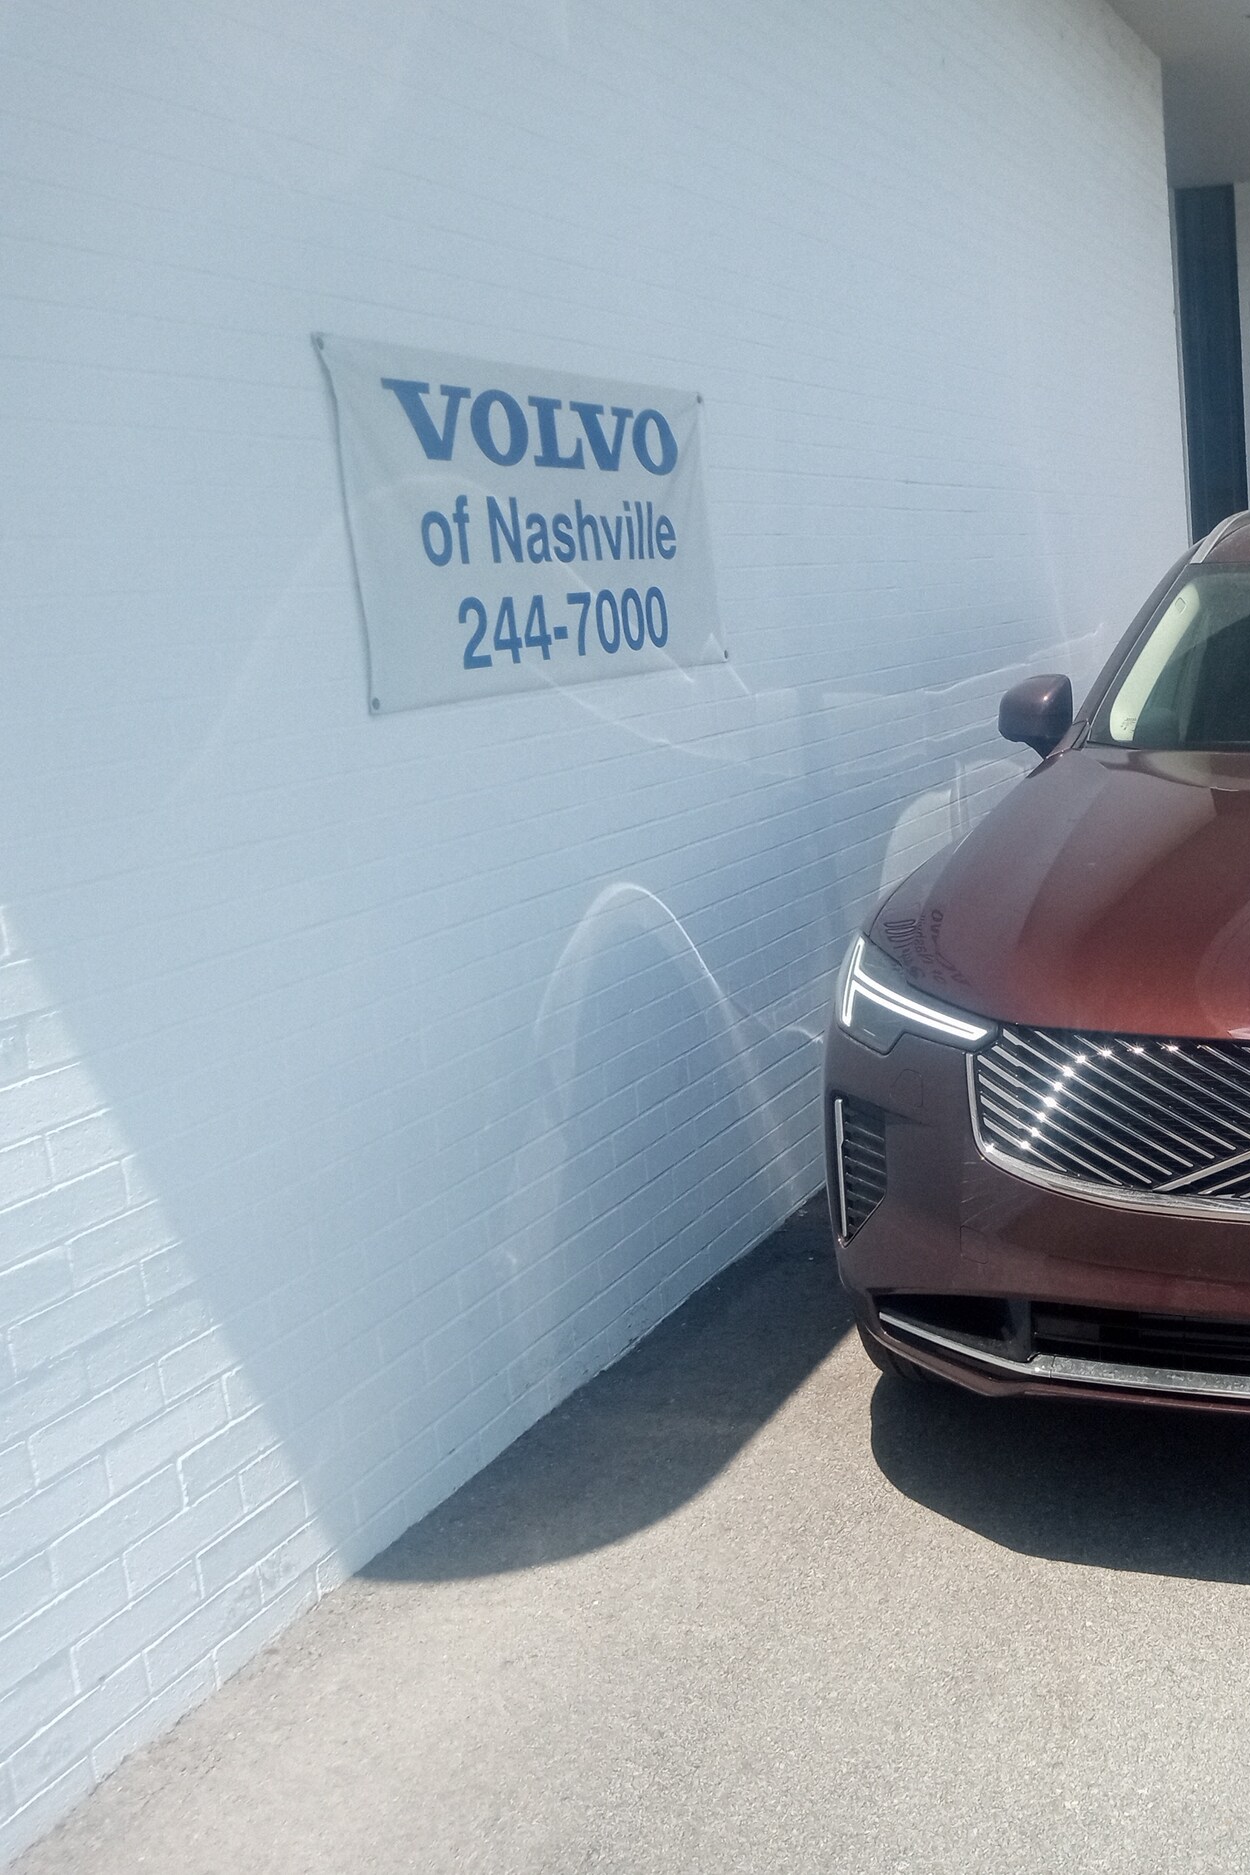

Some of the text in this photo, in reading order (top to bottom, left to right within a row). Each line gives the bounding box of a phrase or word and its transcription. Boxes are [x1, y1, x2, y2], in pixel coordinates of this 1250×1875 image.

[381, 377, 679, 476] VOLVO
[421, 494, 678, 567] of Nashville
[458, 586, 669, 670] 244-7000
